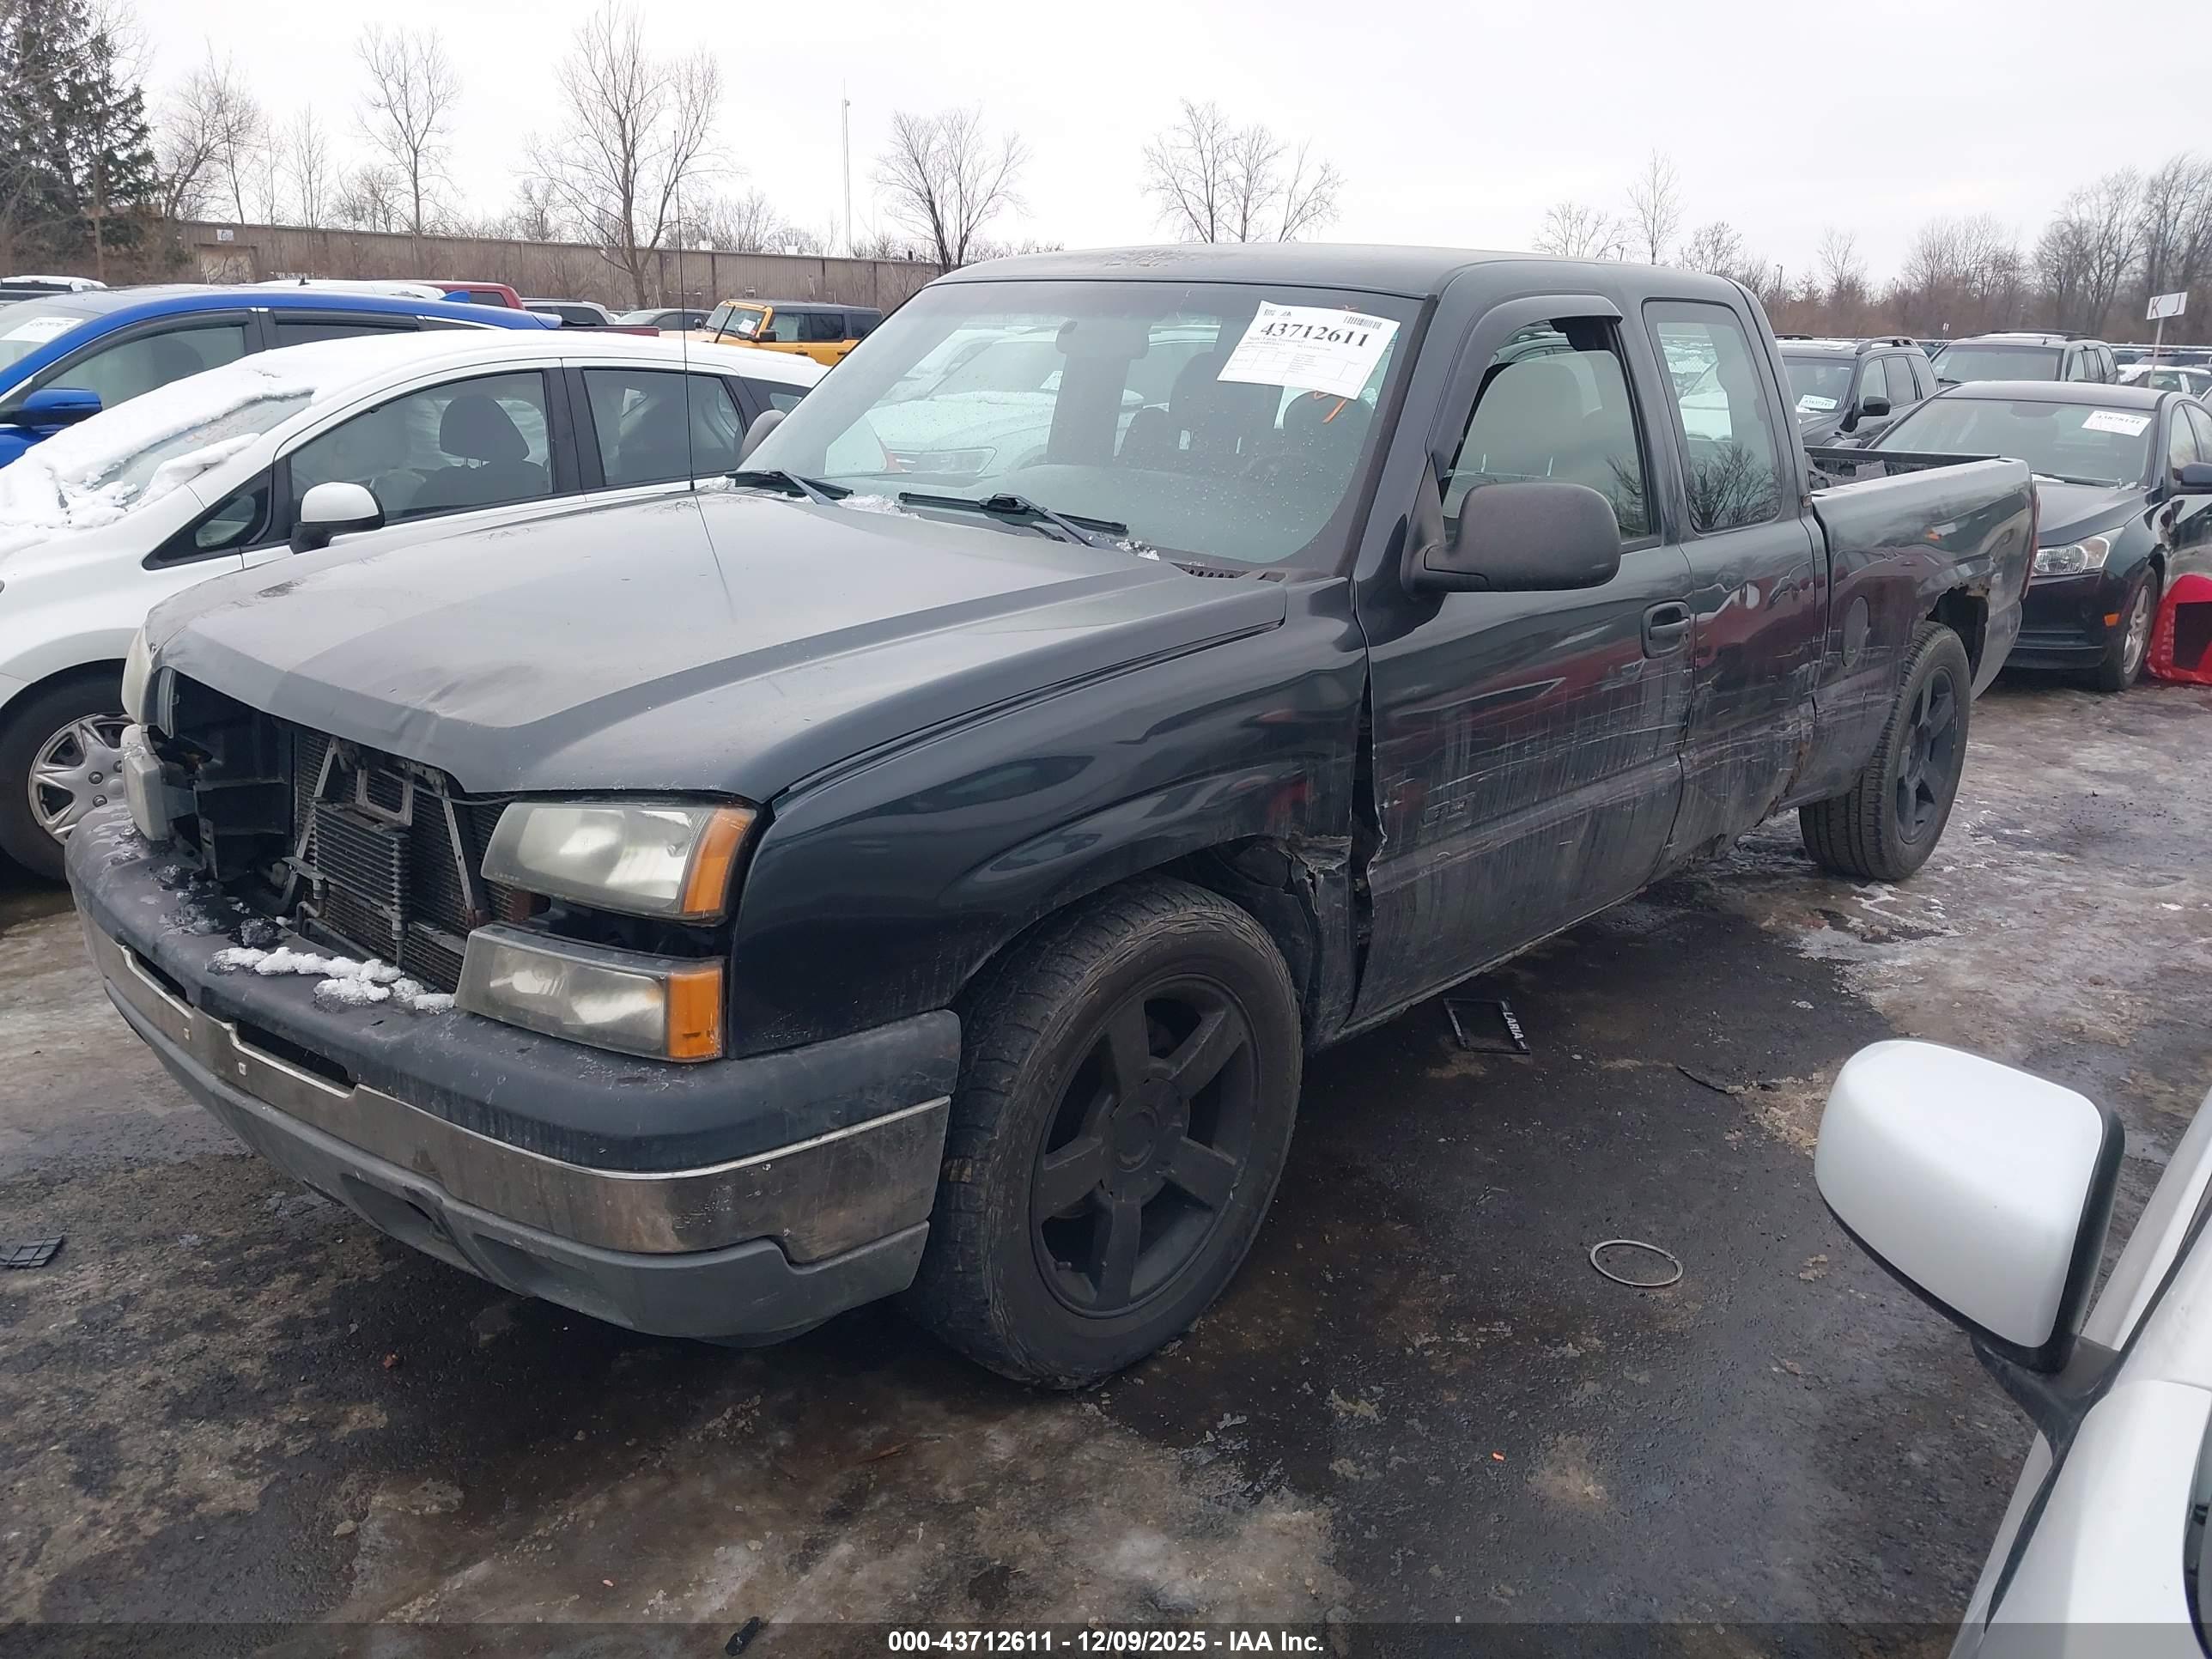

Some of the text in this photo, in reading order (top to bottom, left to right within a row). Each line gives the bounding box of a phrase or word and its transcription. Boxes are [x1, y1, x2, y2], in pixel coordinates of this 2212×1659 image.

[2150, 294, 2182, 318] K J
[1261, 322, 1370, 347] 43712611
